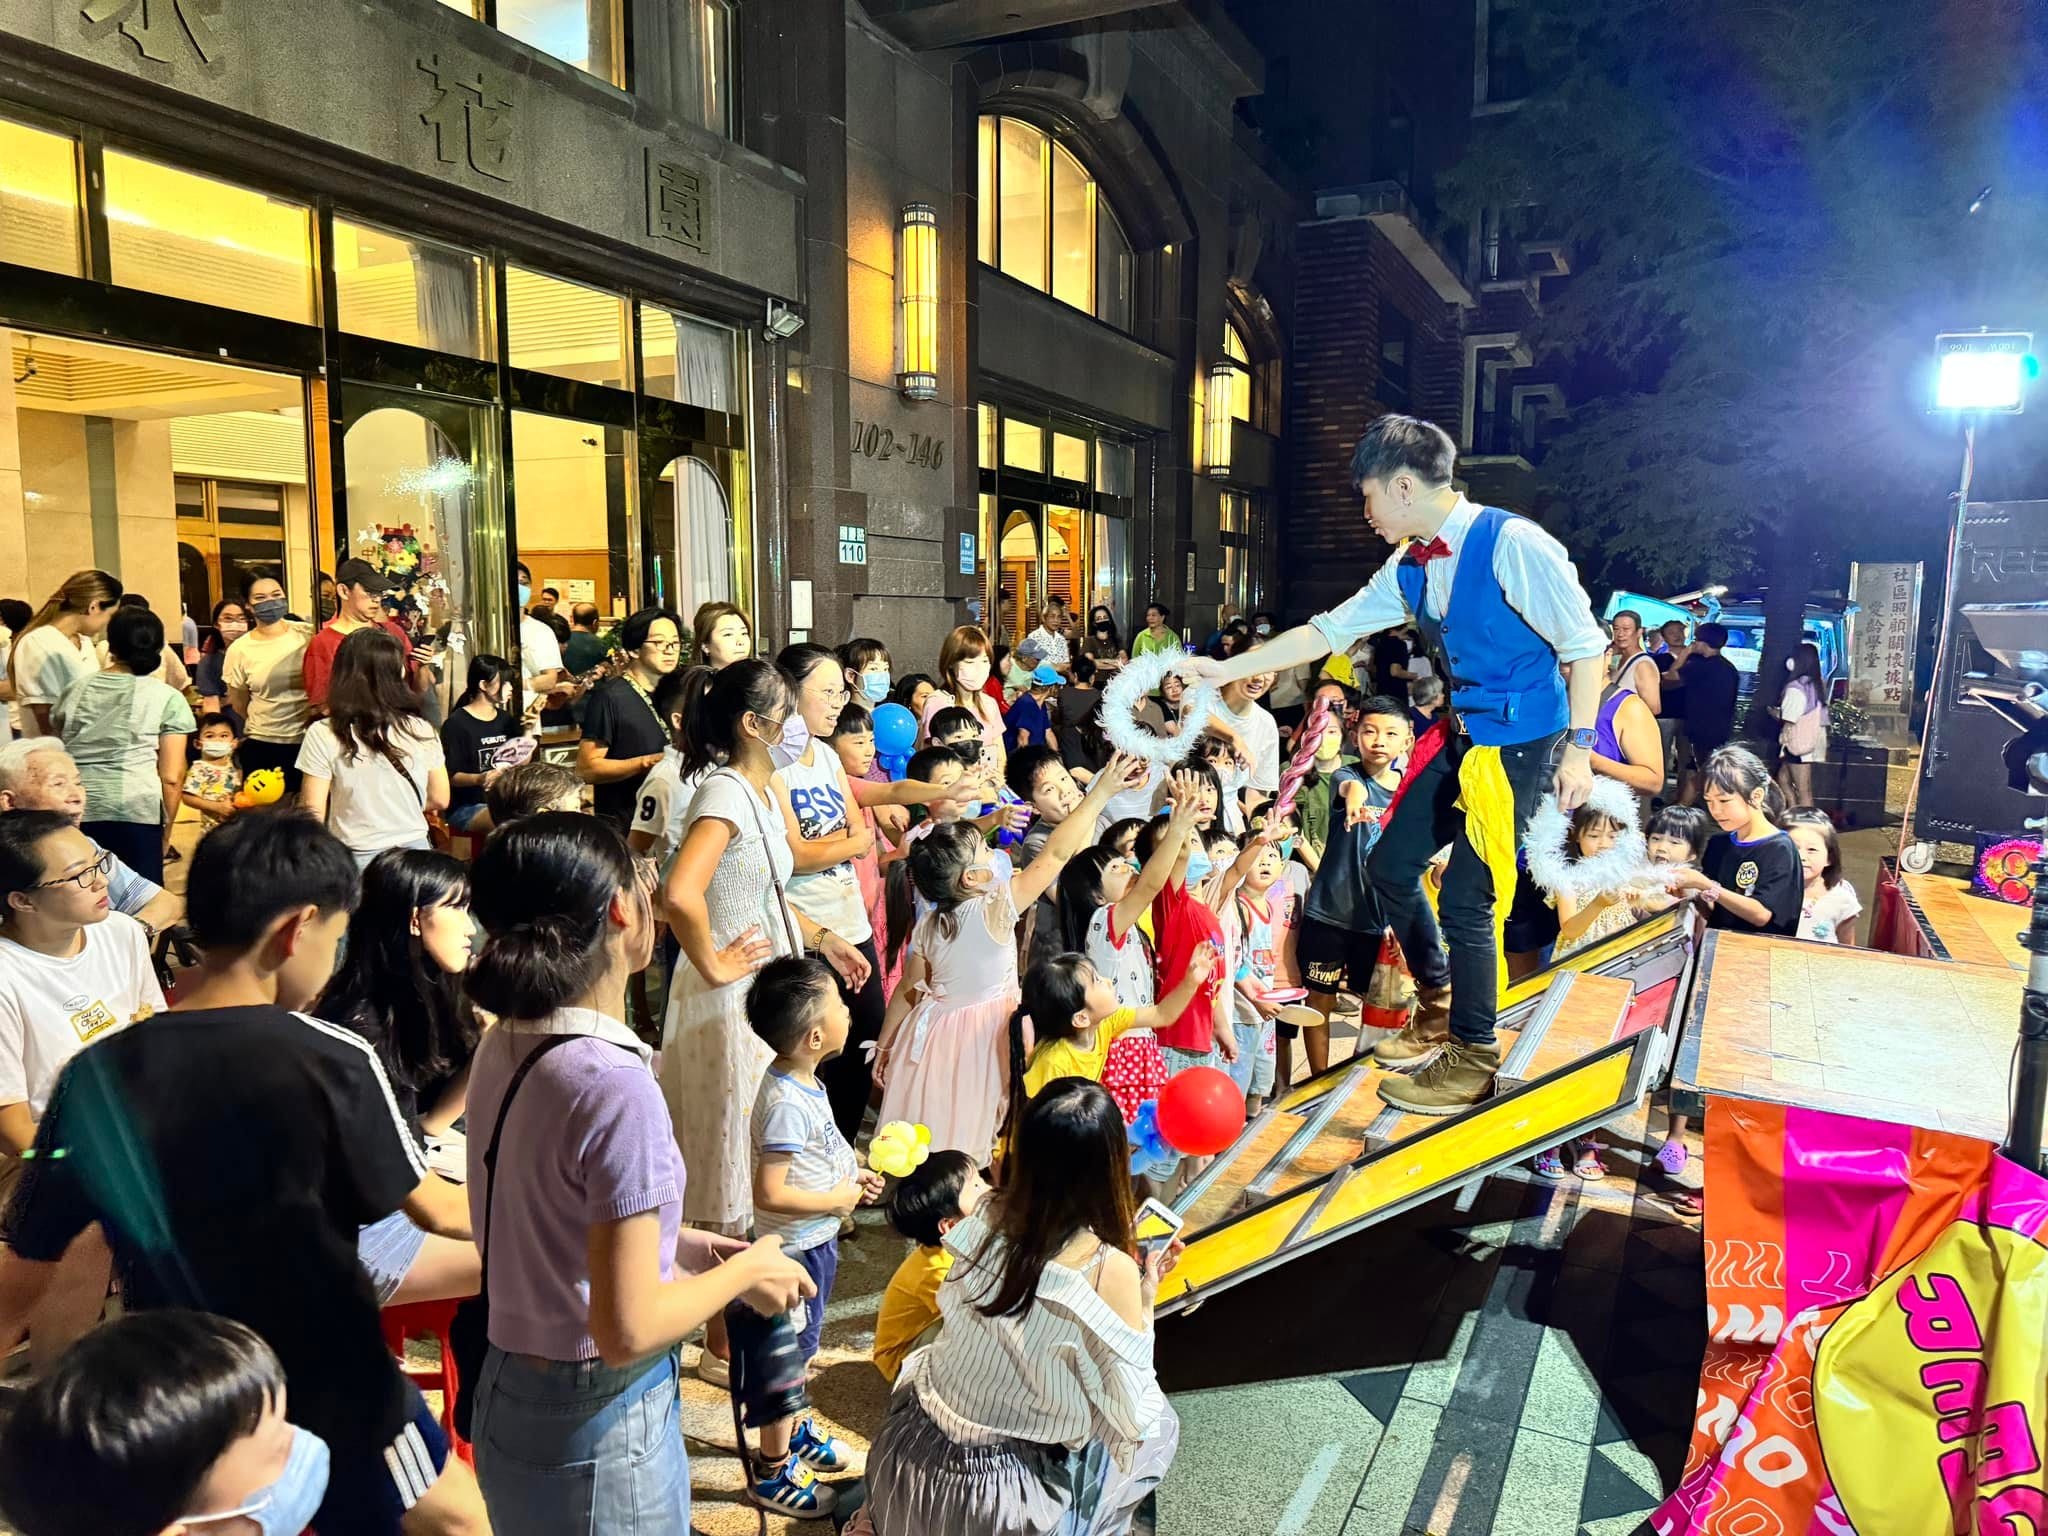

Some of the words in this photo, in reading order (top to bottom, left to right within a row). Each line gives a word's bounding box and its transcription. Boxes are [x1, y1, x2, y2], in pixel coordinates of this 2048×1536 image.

[842, 544, 864, 562] 110
[1884, 567, 1909, 701] 社區照顧關懷據點
